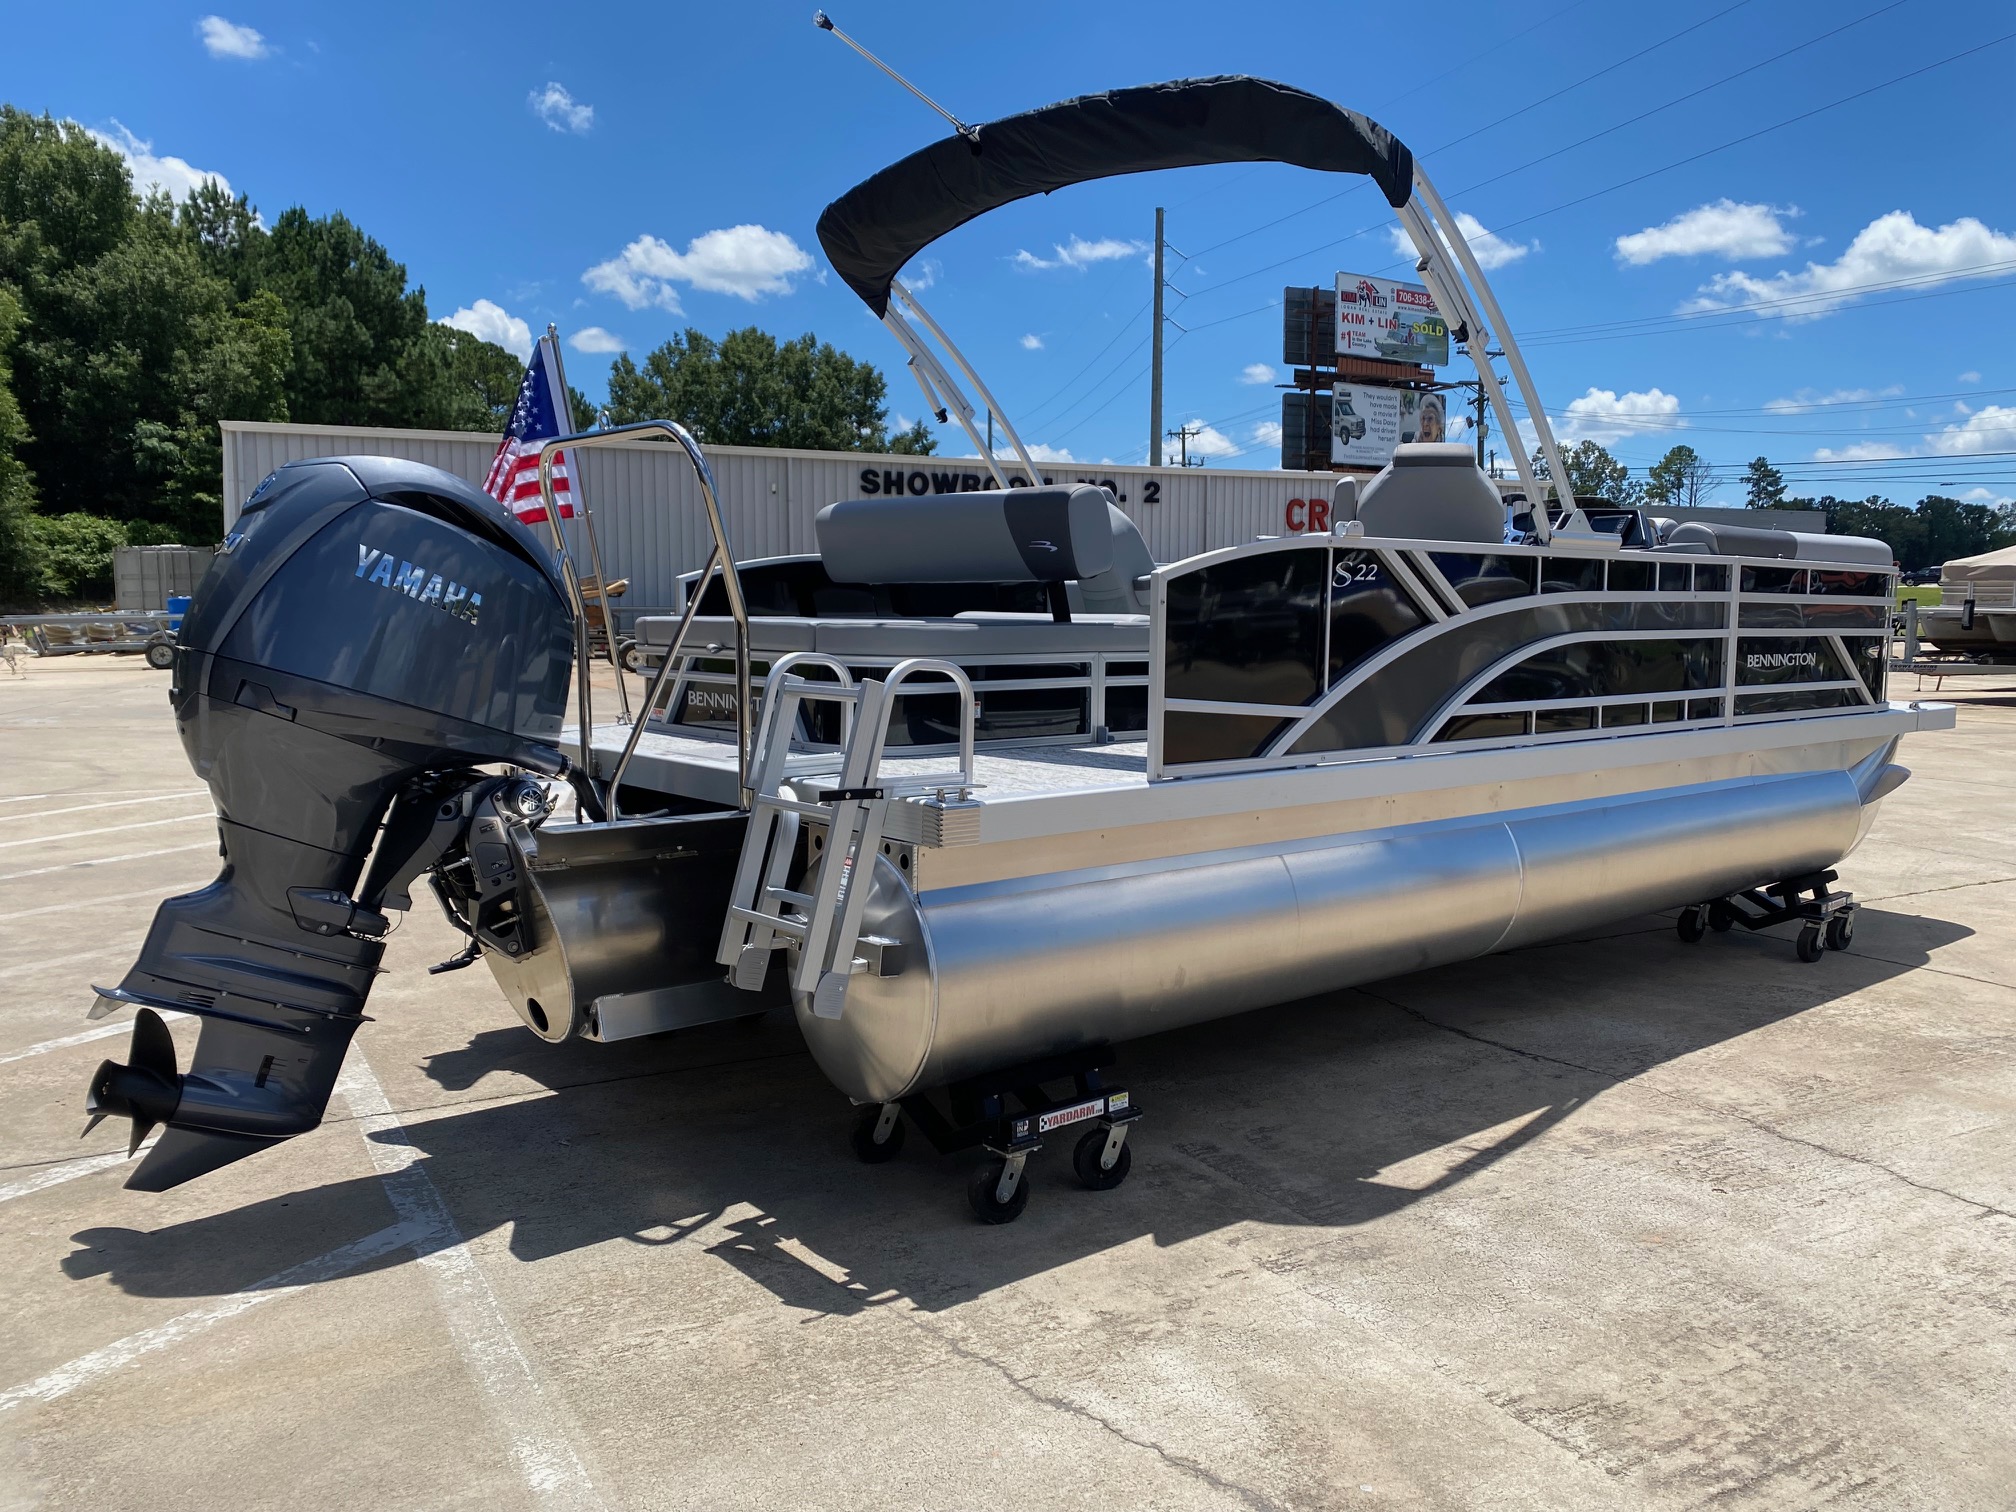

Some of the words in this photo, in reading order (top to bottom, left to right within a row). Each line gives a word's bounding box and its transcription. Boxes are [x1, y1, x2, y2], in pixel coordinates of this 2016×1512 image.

[1342, 292, 1356, 302] KIM
[1376, 297, 1387, 307] LIN
[1399, 291, 1432, 305] 706-338-
[1342, 312, 1365, 325] KIM
[1378, 317, 1397, 330] LIN
[1413, 321, 1444, 337] SOLD
[1341, 330, 1351, 349] #1
[1363, 391, 1375, 401] They
[1376, 394, 1398, 402] wouldn't
[1370, 401, 1382, 409] have
[1383, 419, 1397, 427] Daisy
[860, 469, 1053, 496] SHOWRO
[1144, 481, 1160, 503] 2
[354, 543, 482, 626] YAMAHA
[1747, 652, 1816, 668] BENNINGTON
[688, 690, 762, 712] BENNINT
